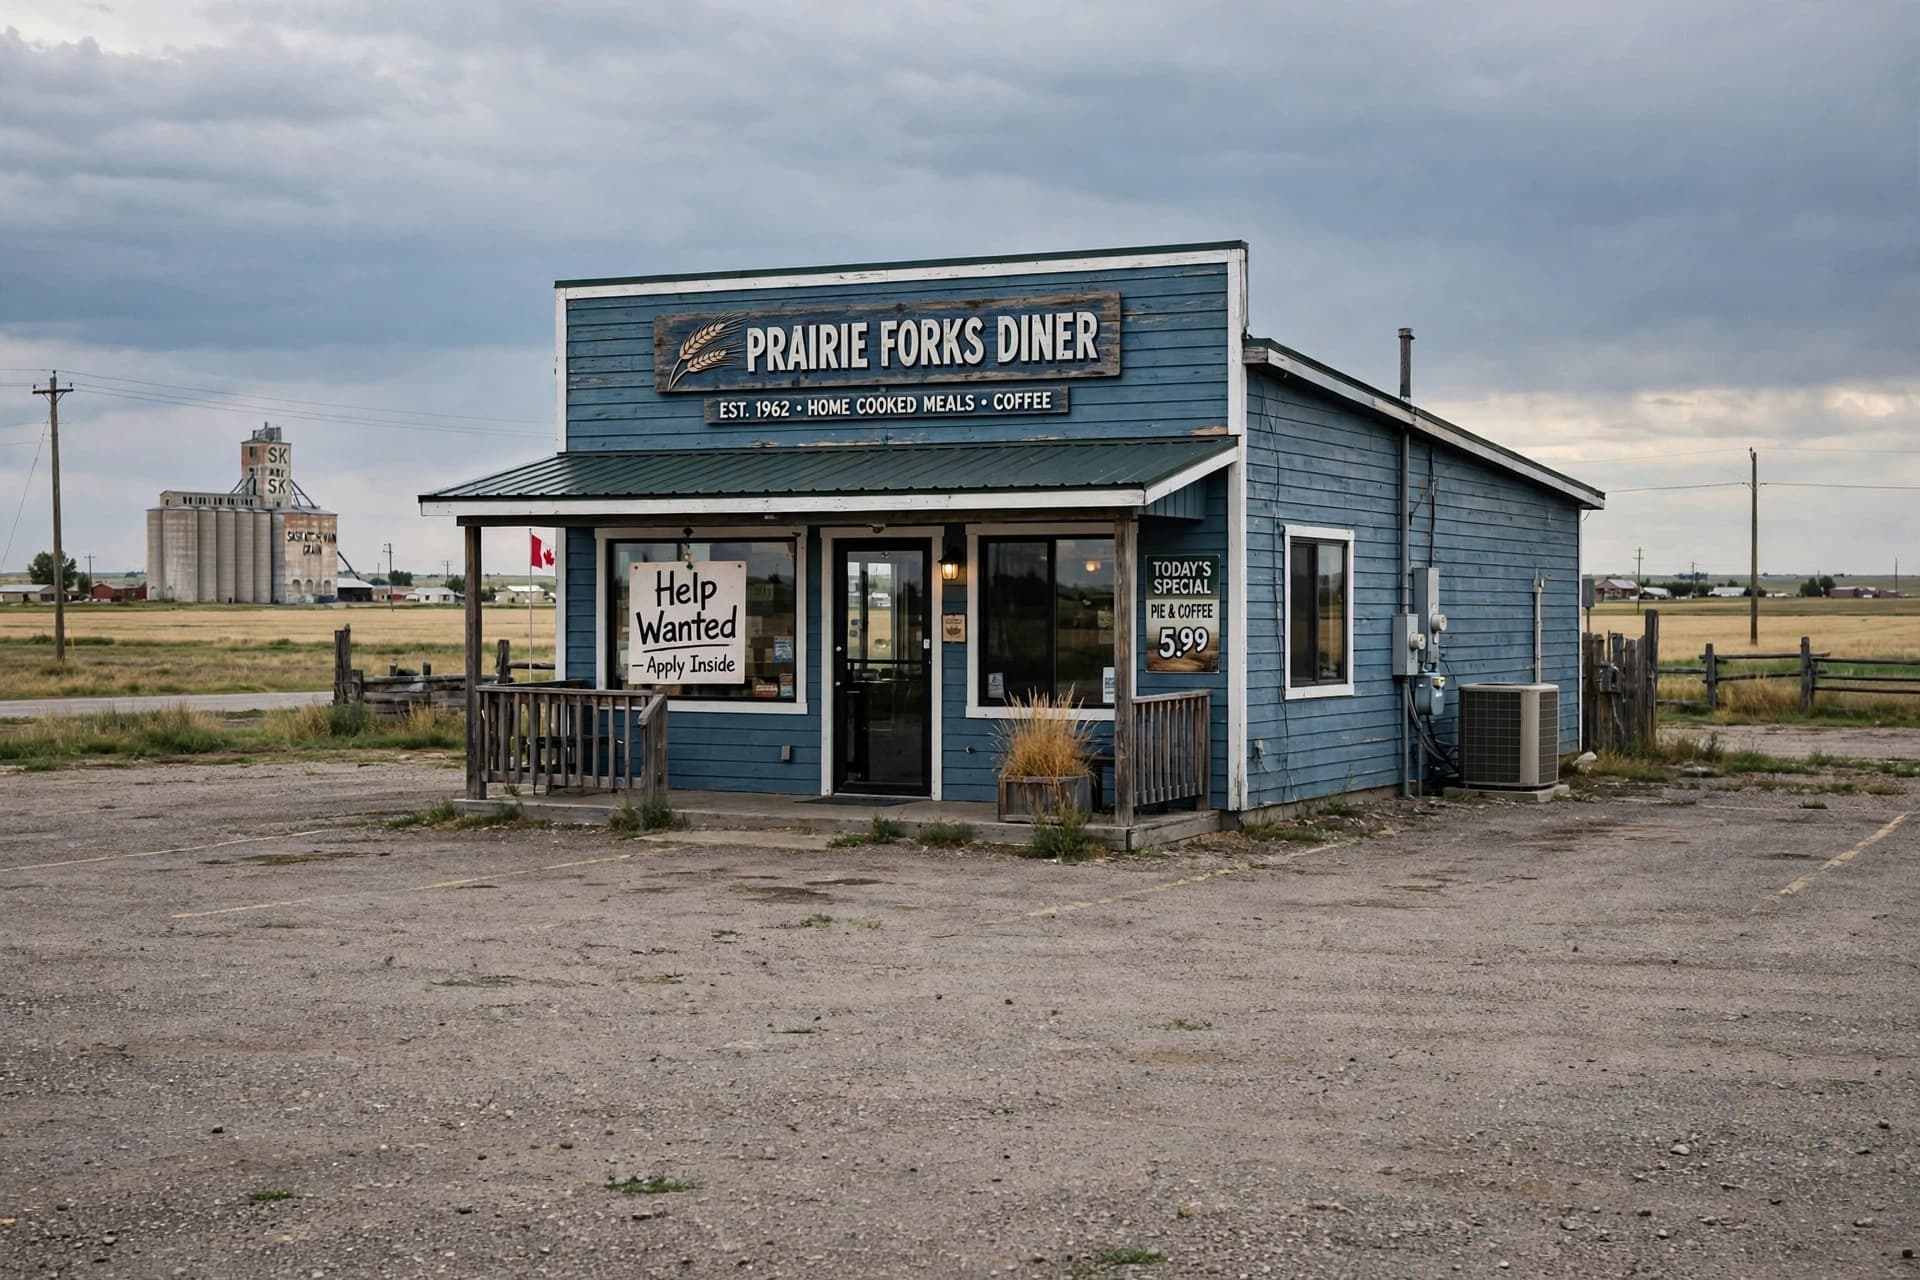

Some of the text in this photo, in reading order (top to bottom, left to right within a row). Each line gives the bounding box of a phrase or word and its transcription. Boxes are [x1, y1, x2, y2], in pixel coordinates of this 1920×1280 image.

[747, 311, 1098, 372] PRAIRIE FORKS DINER
[719, 391, 1052, 419] EST. 1962 HOME COOKED MEALS COFFEE
[268, 446, 287, 464] SK
[268, 478, 286, 494] SK
[1153, 561, 1212, 577] TODAY'S
[655, 570, 718, 611] Help
[1153, 578, 1212, 595] SPECIAL
[635, 604, 738, 645] Wanted
[1151, 603, 1214, 619] PIE & COFFEE
[1159, 627, 1209, 659] 5.99
[646, 653, 736, 680] Apply Inside
